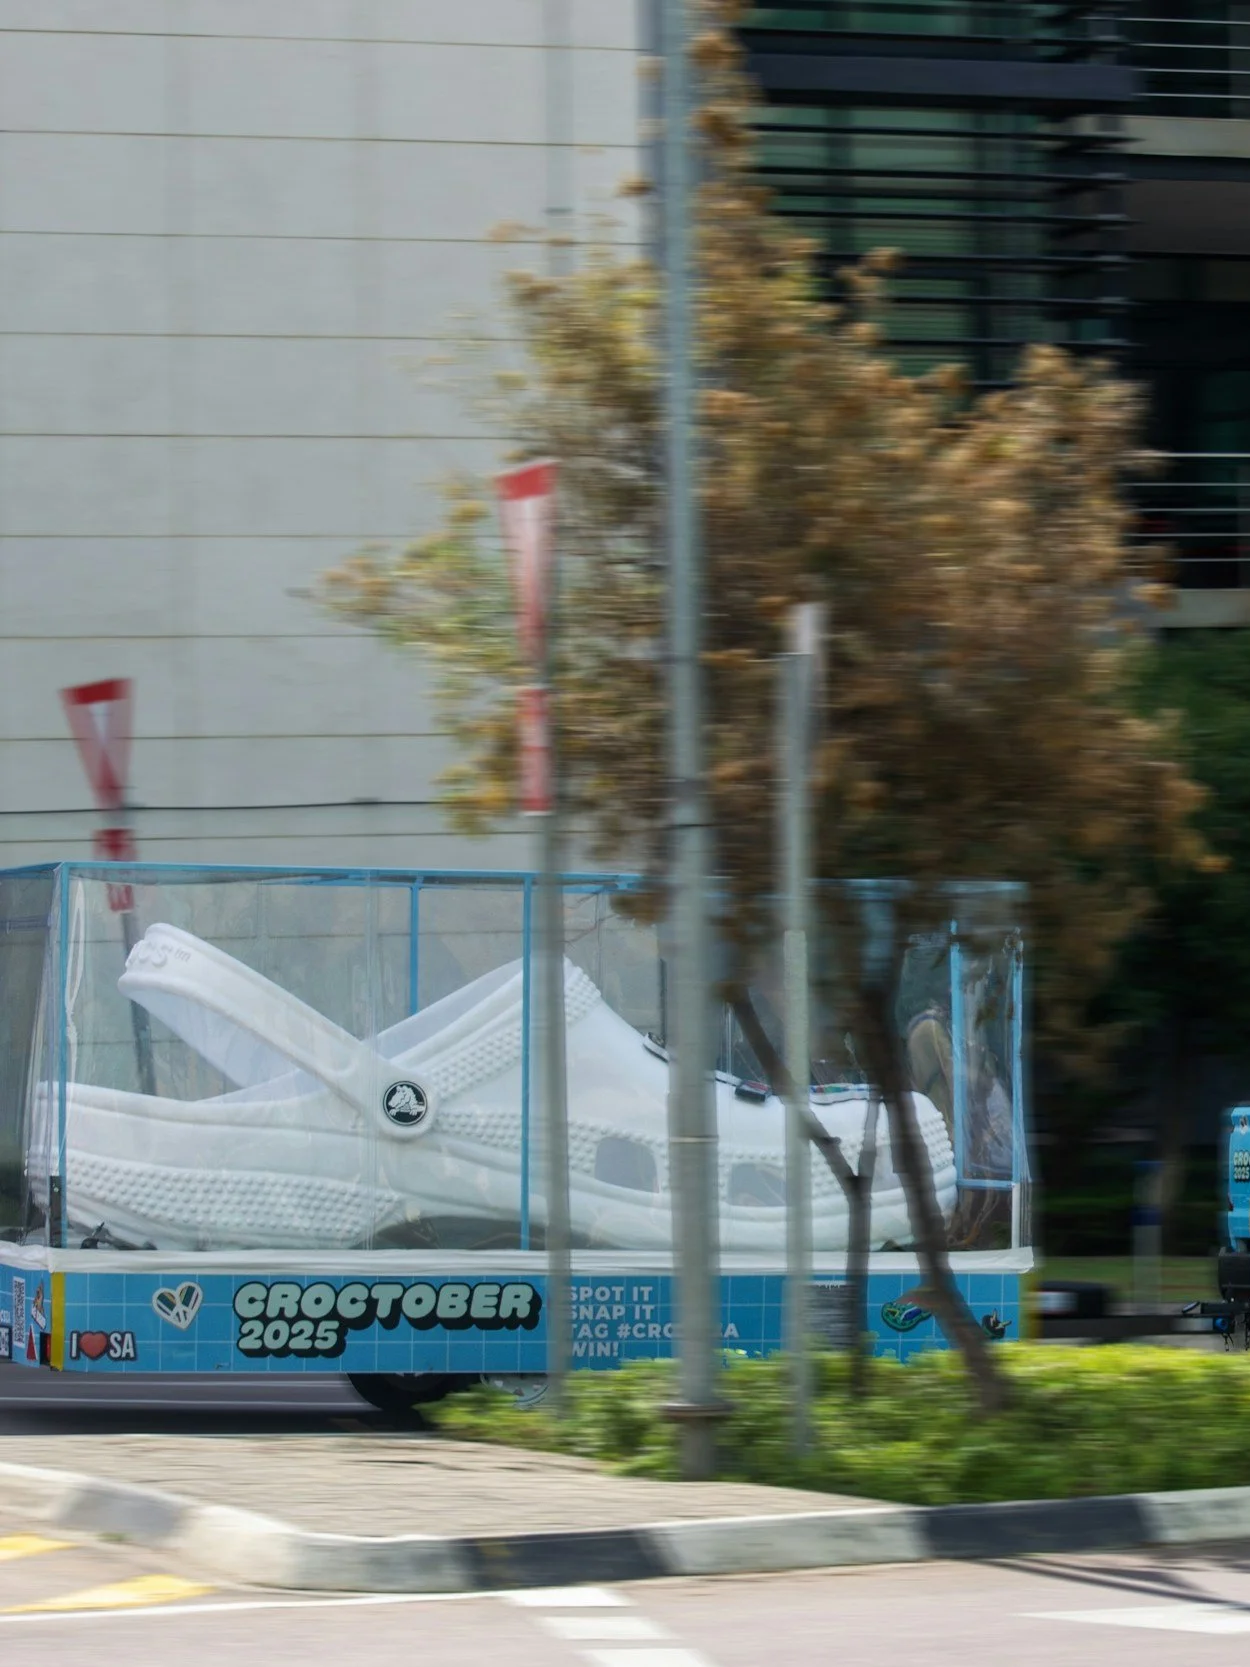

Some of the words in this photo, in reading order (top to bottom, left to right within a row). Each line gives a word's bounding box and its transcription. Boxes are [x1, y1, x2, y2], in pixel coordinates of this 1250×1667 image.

[234, 1281, 538, 1326] CROCTOBER
[632, 1286, 653, 1301] IT
[634, 1304, 655, 1320] IT
[70, 1332, 78, 1358] I
[109, 1332, 135, 1358] SA
[237, 1320, 342, 1352] 2025
